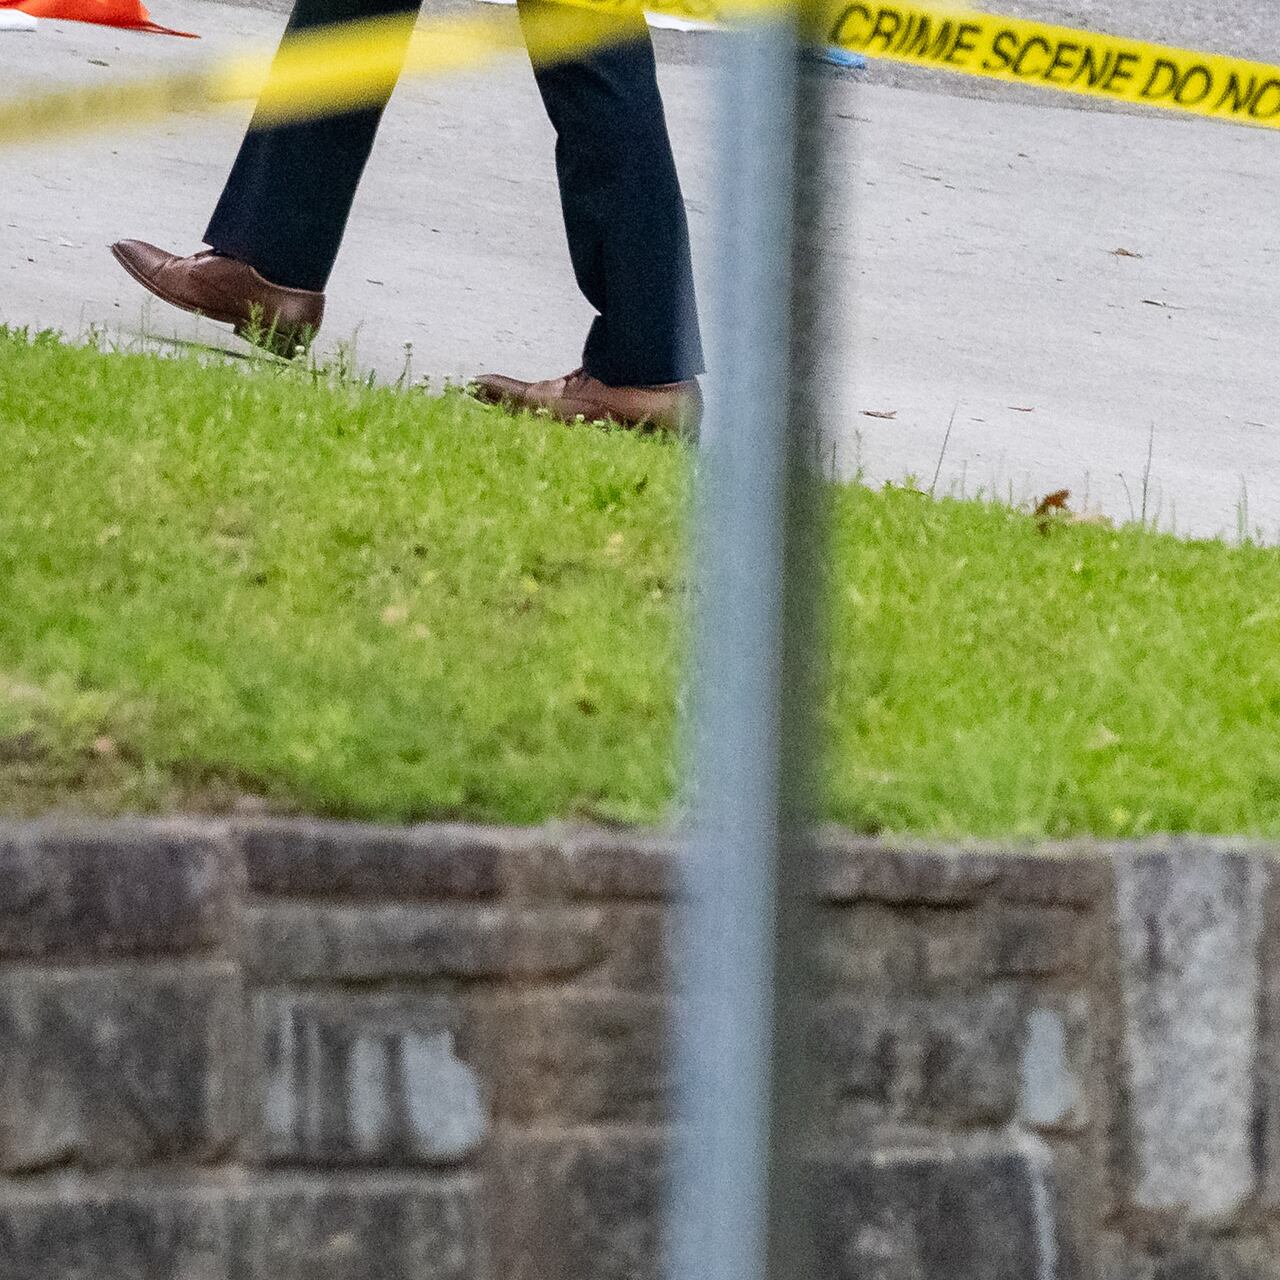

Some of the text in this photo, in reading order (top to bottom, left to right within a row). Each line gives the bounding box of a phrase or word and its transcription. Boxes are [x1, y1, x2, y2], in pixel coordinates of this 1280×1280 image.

[827, 2, 983, 66] CRIME
[981, 29, 1139, 94] SCENE
[1139, 57, 1213, 106] DO
